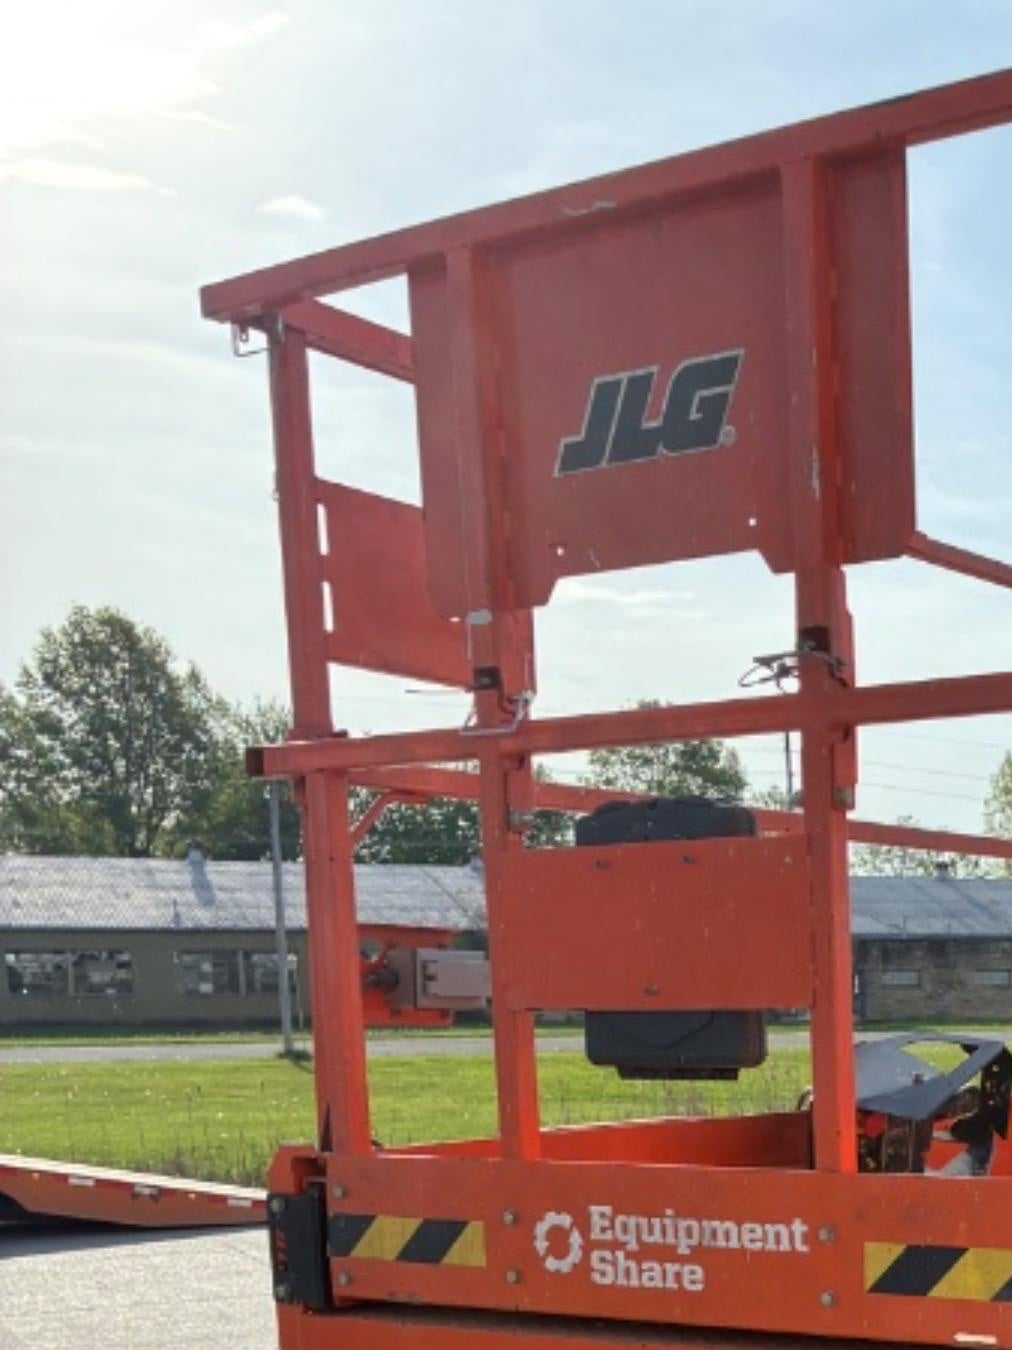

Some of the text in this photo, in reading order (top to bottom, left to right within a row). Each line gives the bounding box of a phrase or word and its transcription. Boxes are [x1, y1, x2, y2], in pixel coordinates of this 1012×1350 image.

[552, 347, 745, 478] JLG
[588, 1204, 810, 1254] Equipment
[590, 1250, 705, 1291] Share
